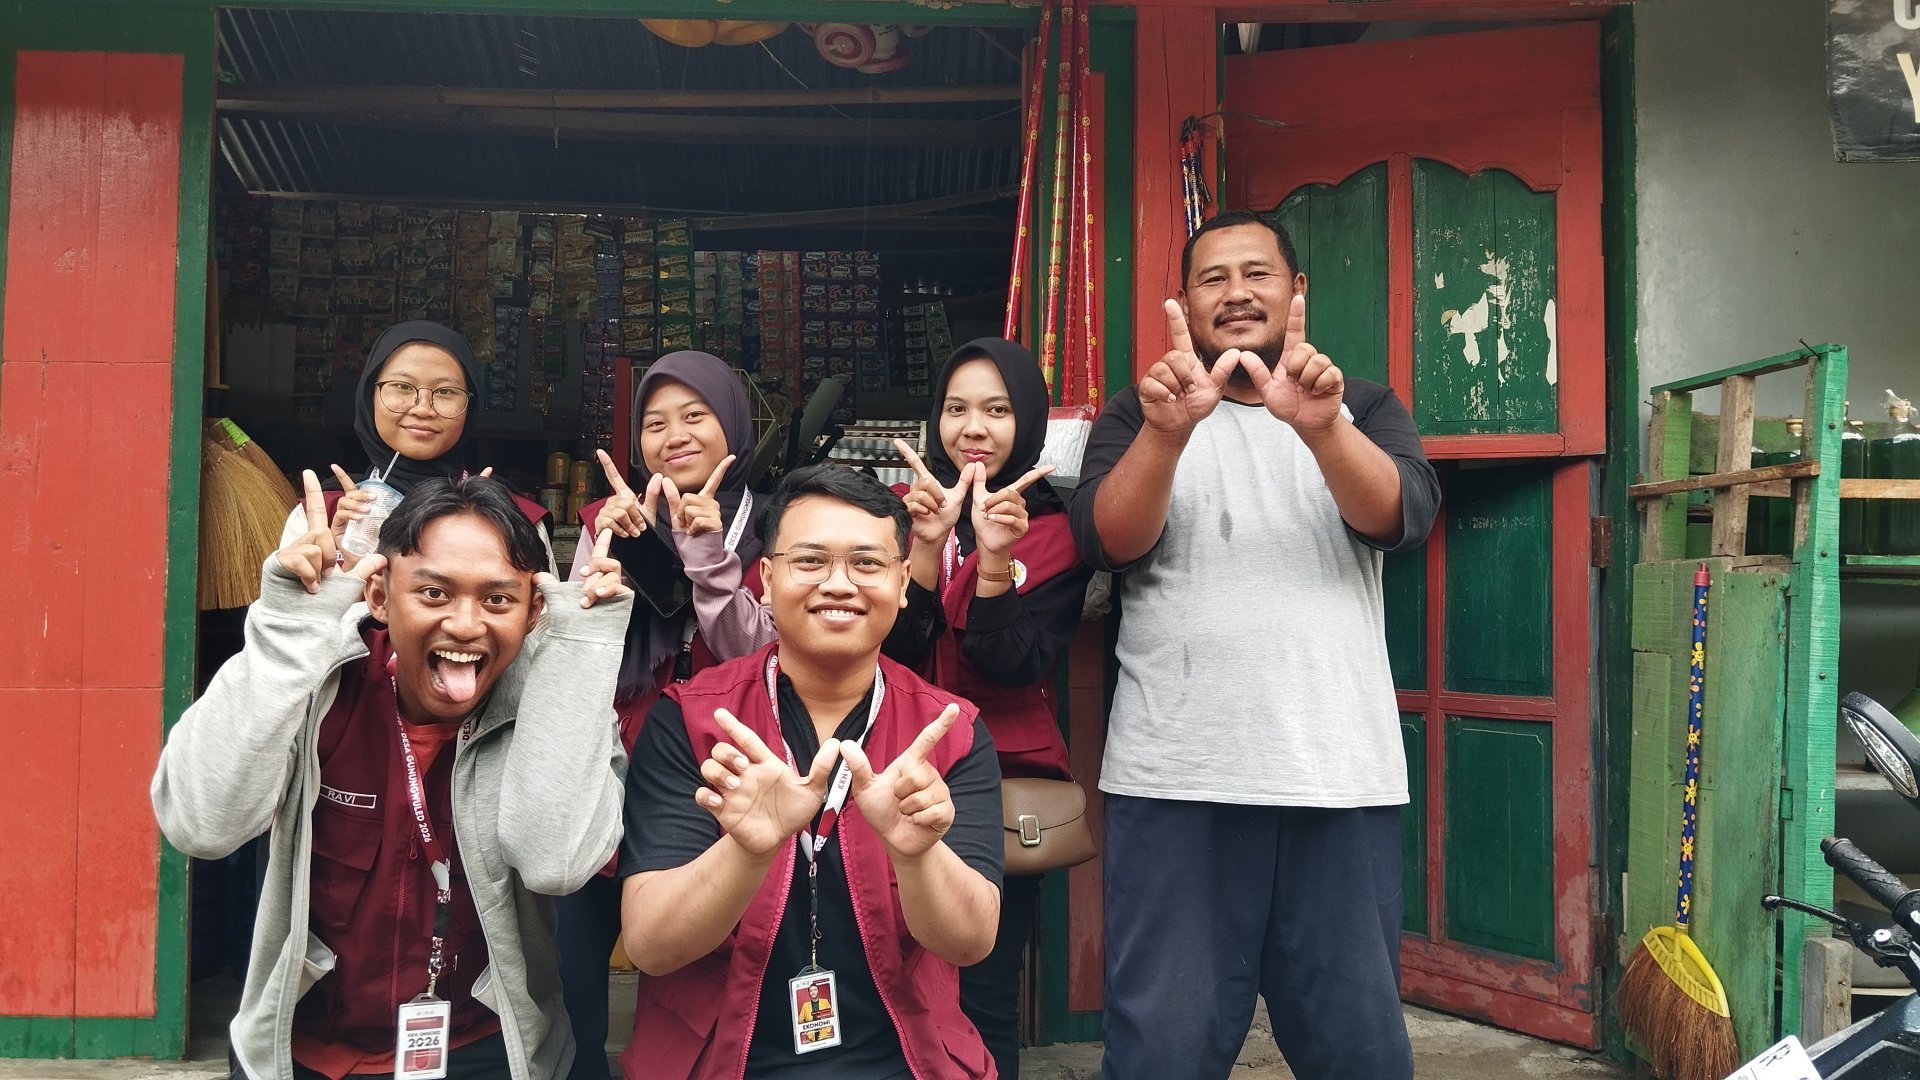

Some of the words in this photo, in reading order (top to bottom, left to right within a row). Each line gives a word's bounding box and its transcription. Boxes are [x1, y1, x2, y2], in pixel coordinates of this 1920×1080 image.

[403, 296, 424, 304] TOP
[728, 532, 738, 546] DESA
[401, 733, 411, 753] DESA
[406, 755, 425, 821] GUNUNGWULED
[419, 822, 432, 843] 2026
[836, 772, 848, 790] KKN
[328, 790, 356, 804] RAVI
[803, 1021, 830, 1030] EKONOMI
[408, 1036, 440, 1048] 2026
